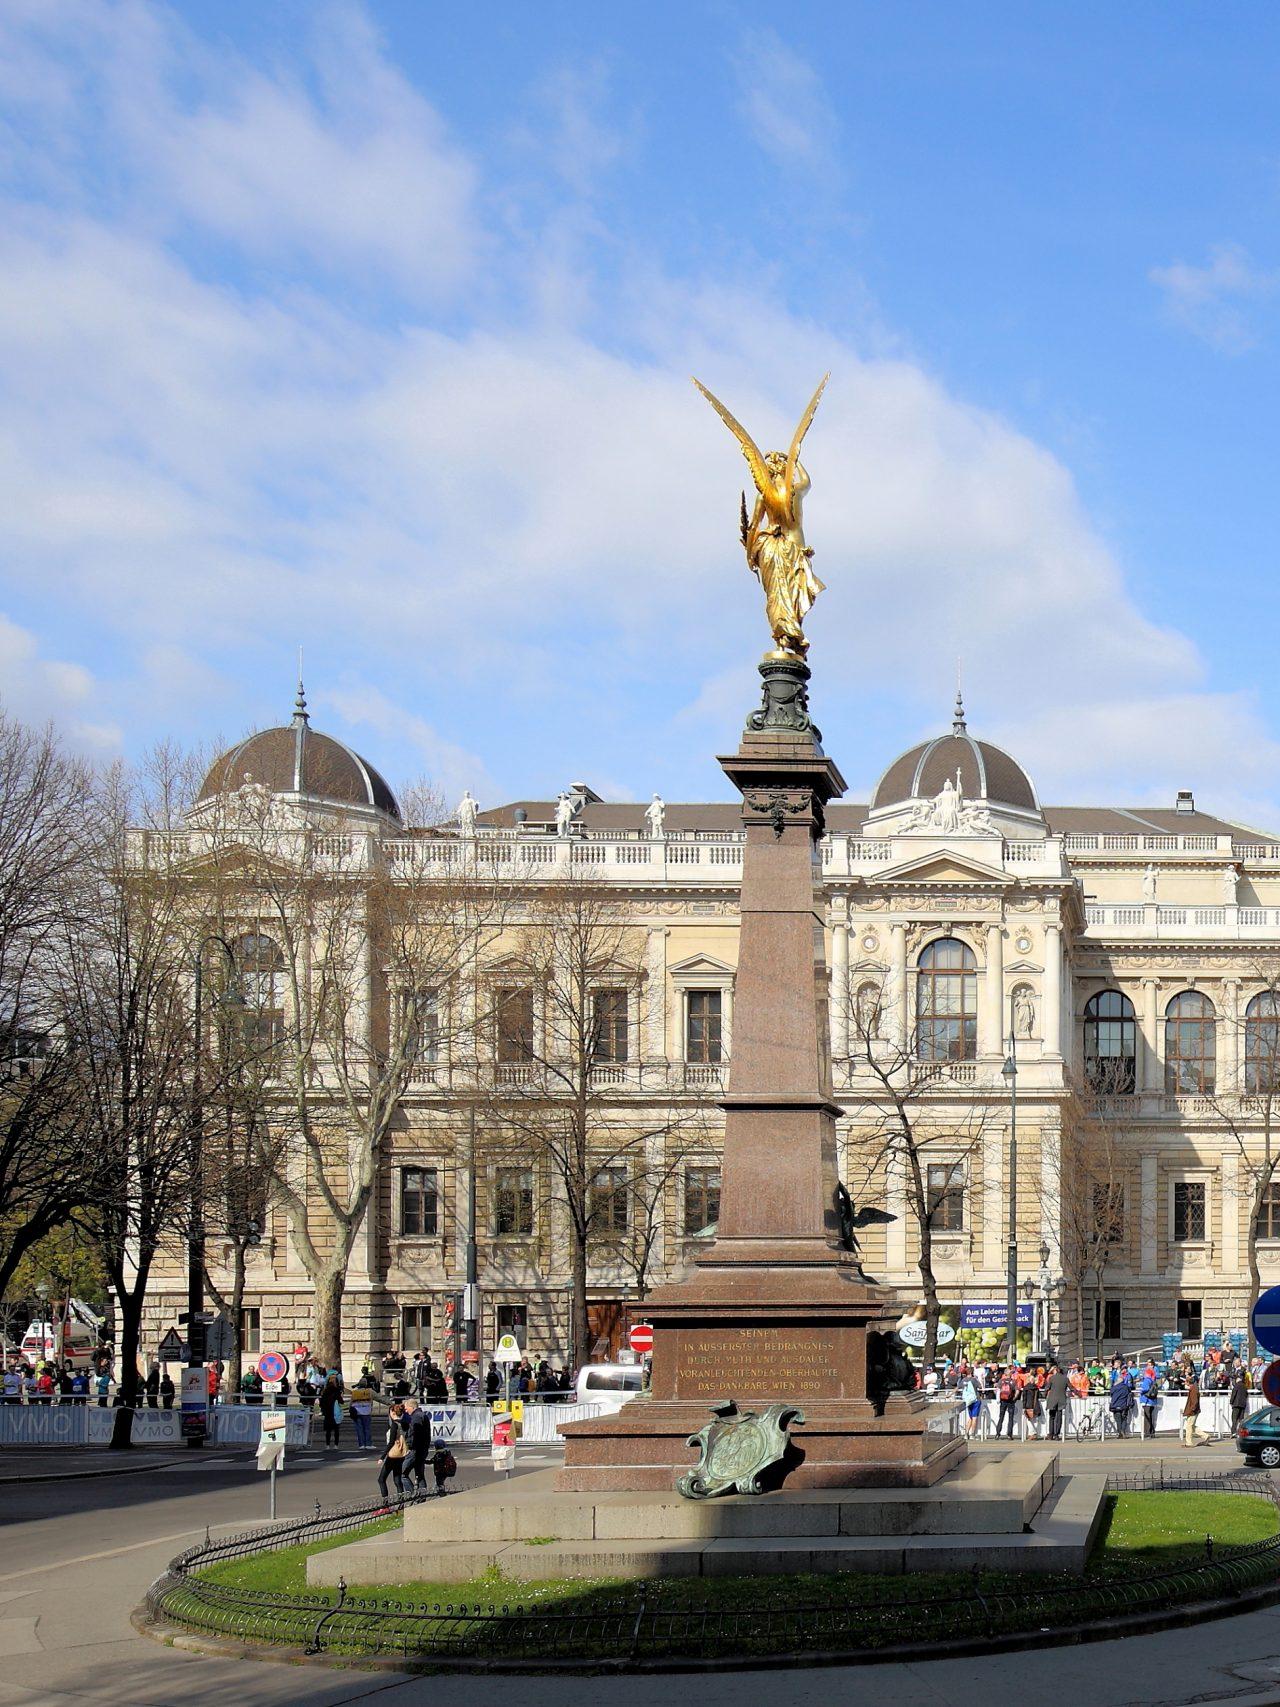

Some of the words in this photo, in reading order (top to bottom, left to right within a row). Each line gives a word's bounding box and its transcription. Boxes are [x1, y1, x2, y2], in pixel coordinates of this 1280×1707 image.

[966, 1308, 979, 1316] Aus
[966, 1316, 976, 1324] für
[740, 1329, 778, 1338] SEINEM
[684, 1343, 694, 1351] IN
[698, 1382, 716, 1391] DAS
[719, 1381, 768, 1390] DANKBARE
[772, 1381, 796, 1390] WIEN
[800, 1381, 821, 1390] 1890
